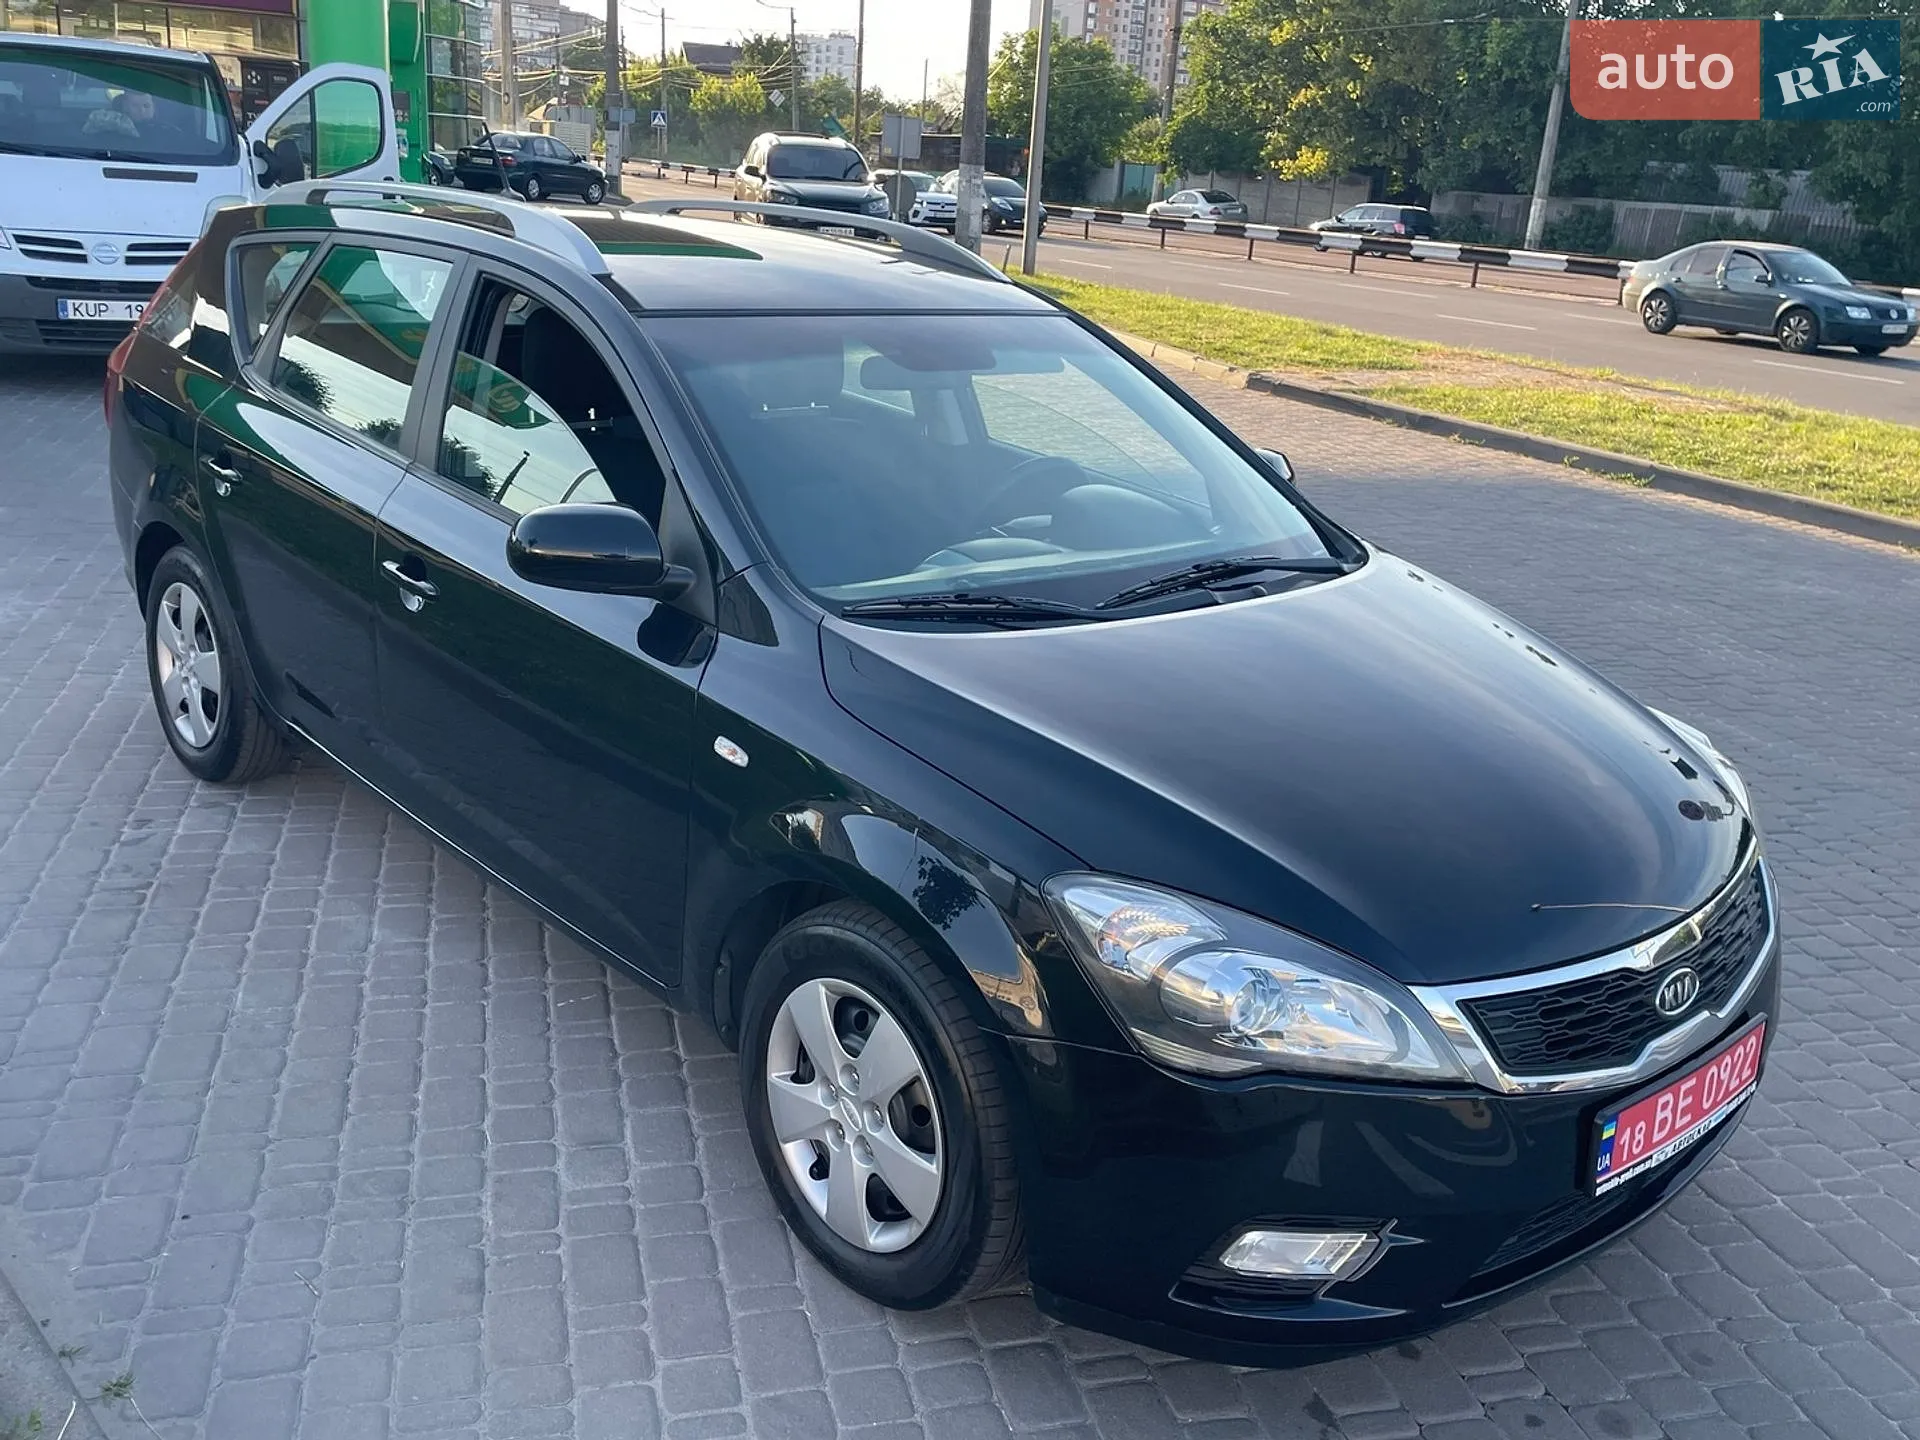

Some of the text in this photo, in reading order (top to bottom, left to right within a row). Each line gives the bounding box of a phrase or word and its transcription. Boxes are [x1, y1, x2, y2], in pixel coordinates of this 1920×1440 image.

[72, 301, 109, 318] KUP
[1663, 973, 1694, 1010] KIA
[1619, 1120, 1647, 1162] 18
[1652, 1077, 1697, 1144] BE
[1702, 1035, 1757, 1110] 0922
[1597, 1153, 1611, 1171] UA
